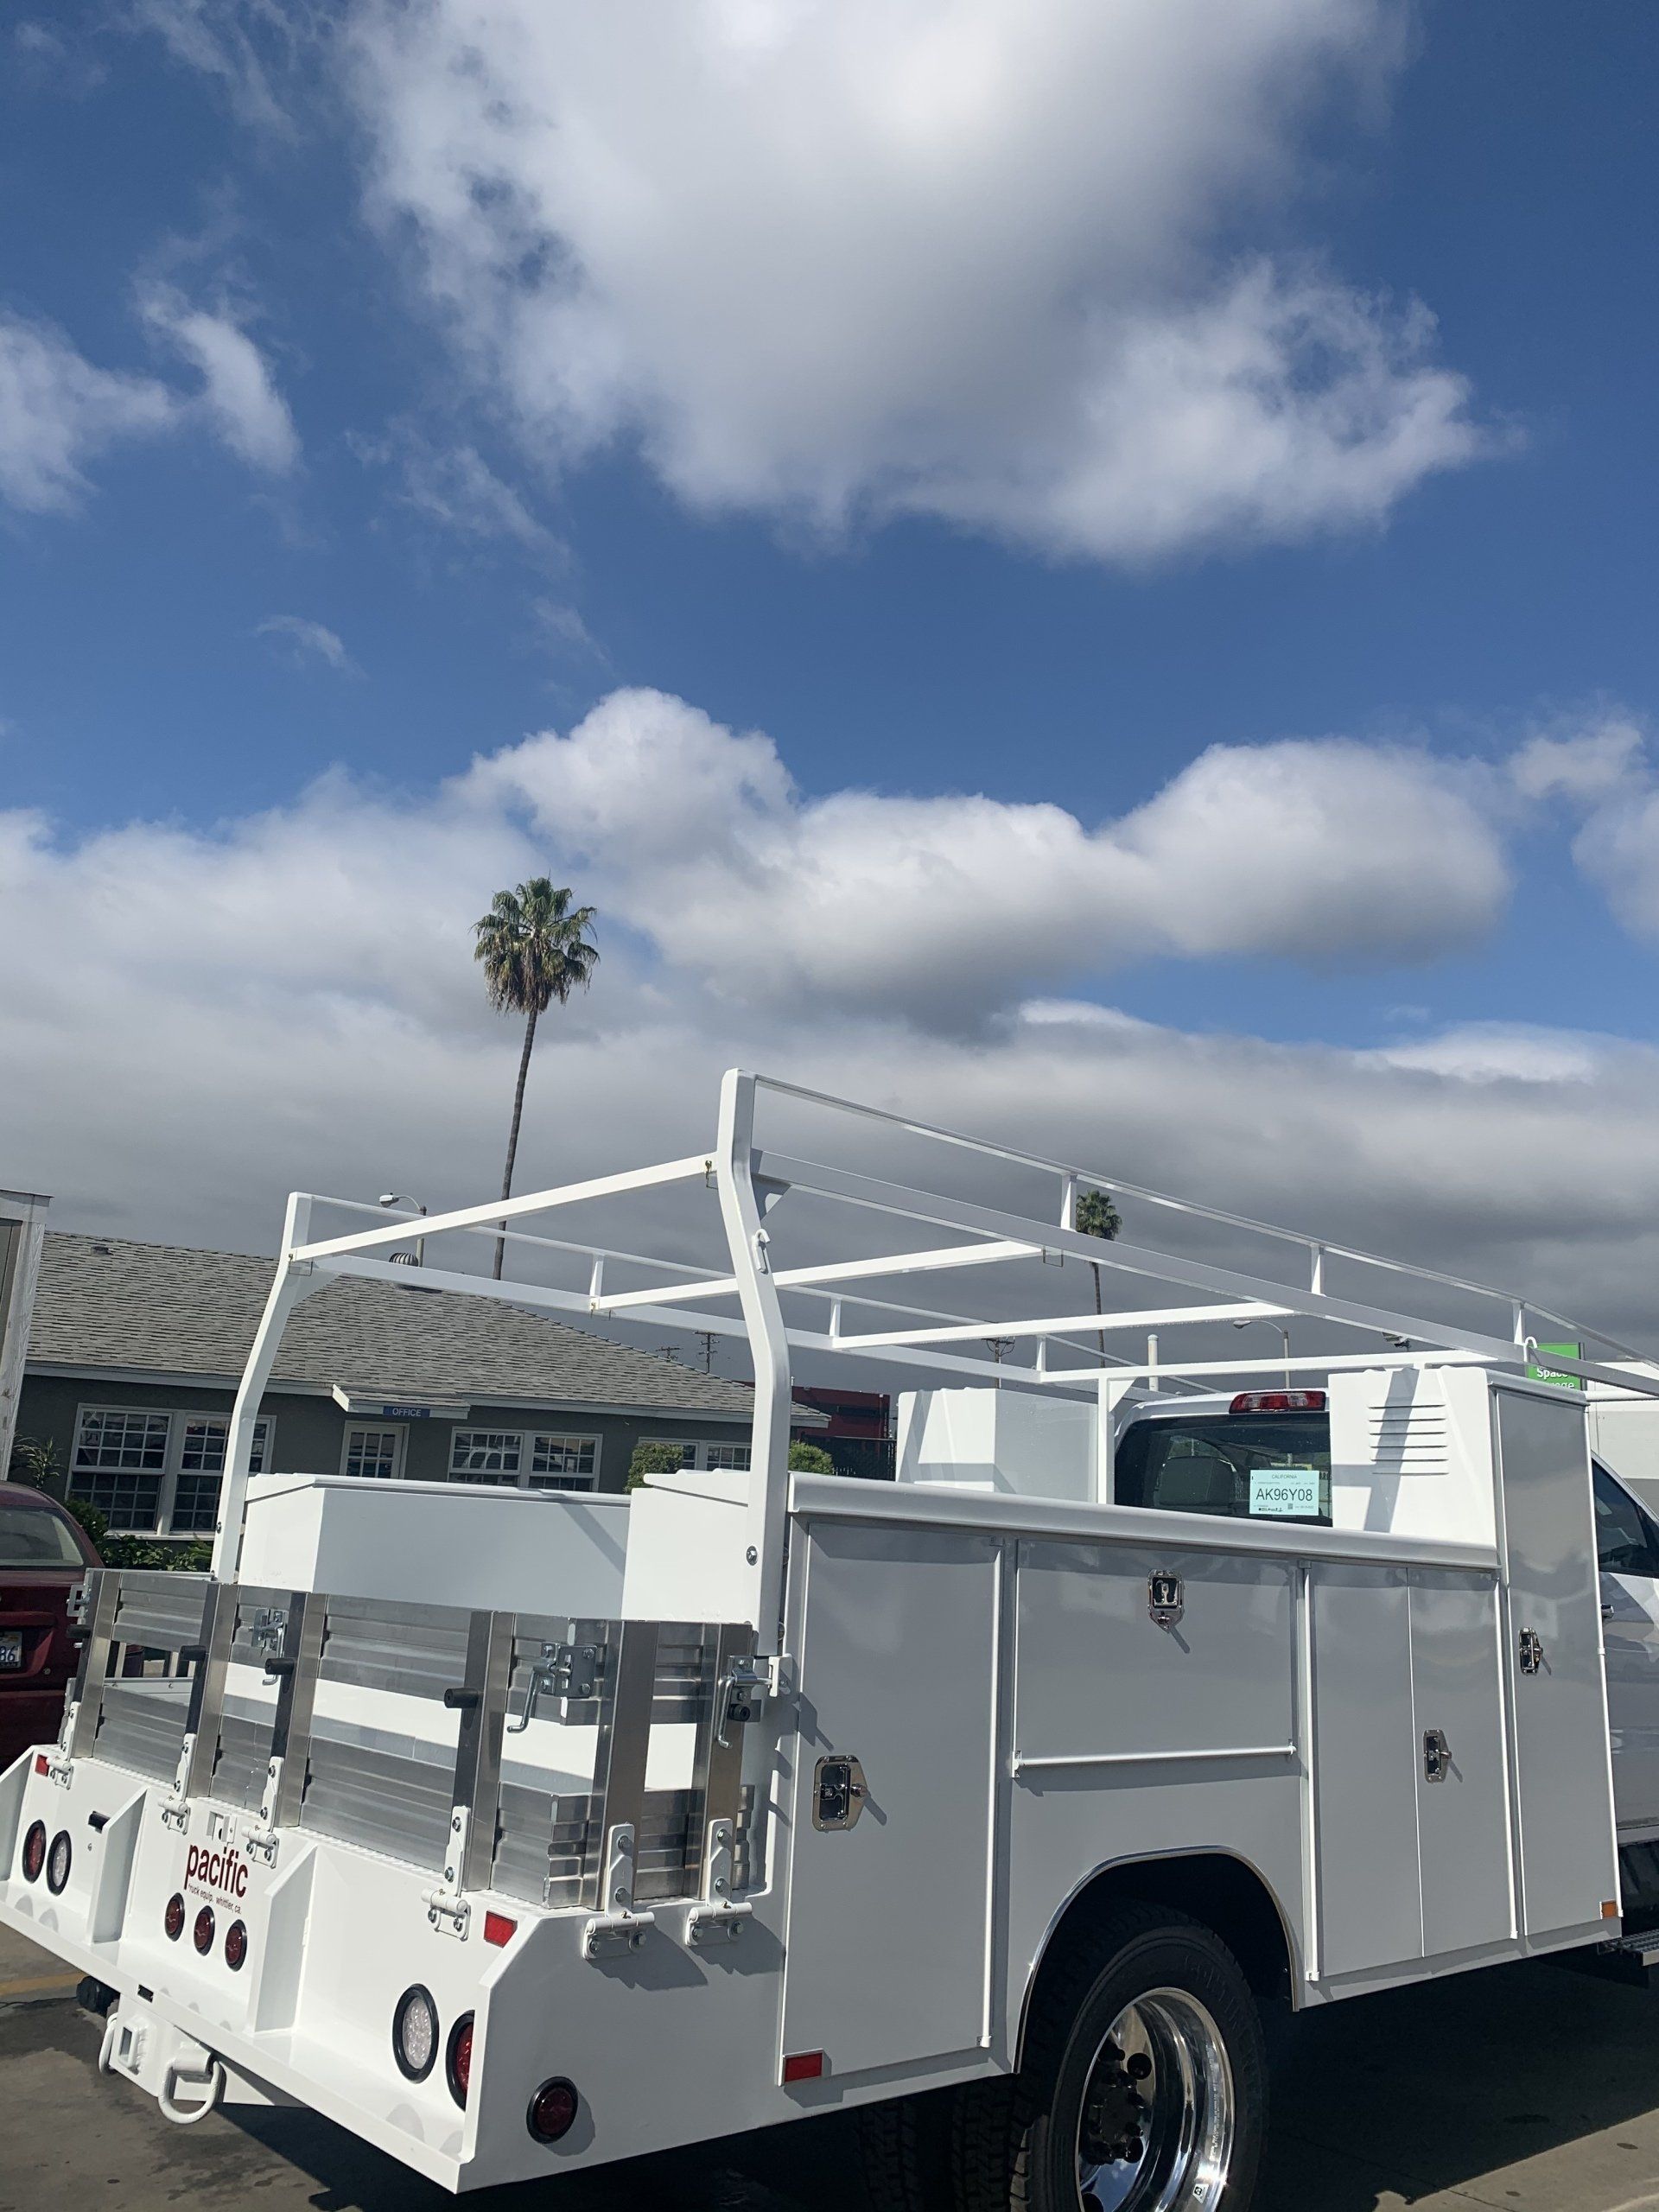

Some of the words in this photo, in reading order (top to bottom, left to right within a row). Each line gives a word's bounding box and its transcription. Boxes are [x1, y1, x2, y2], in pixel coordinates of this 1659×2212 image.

[392, 1408, 422, 1417] OFFICE
[1255, 1488, 1313, 1502] AK96Y08
[184, 1845, 248, 1897] pacific
